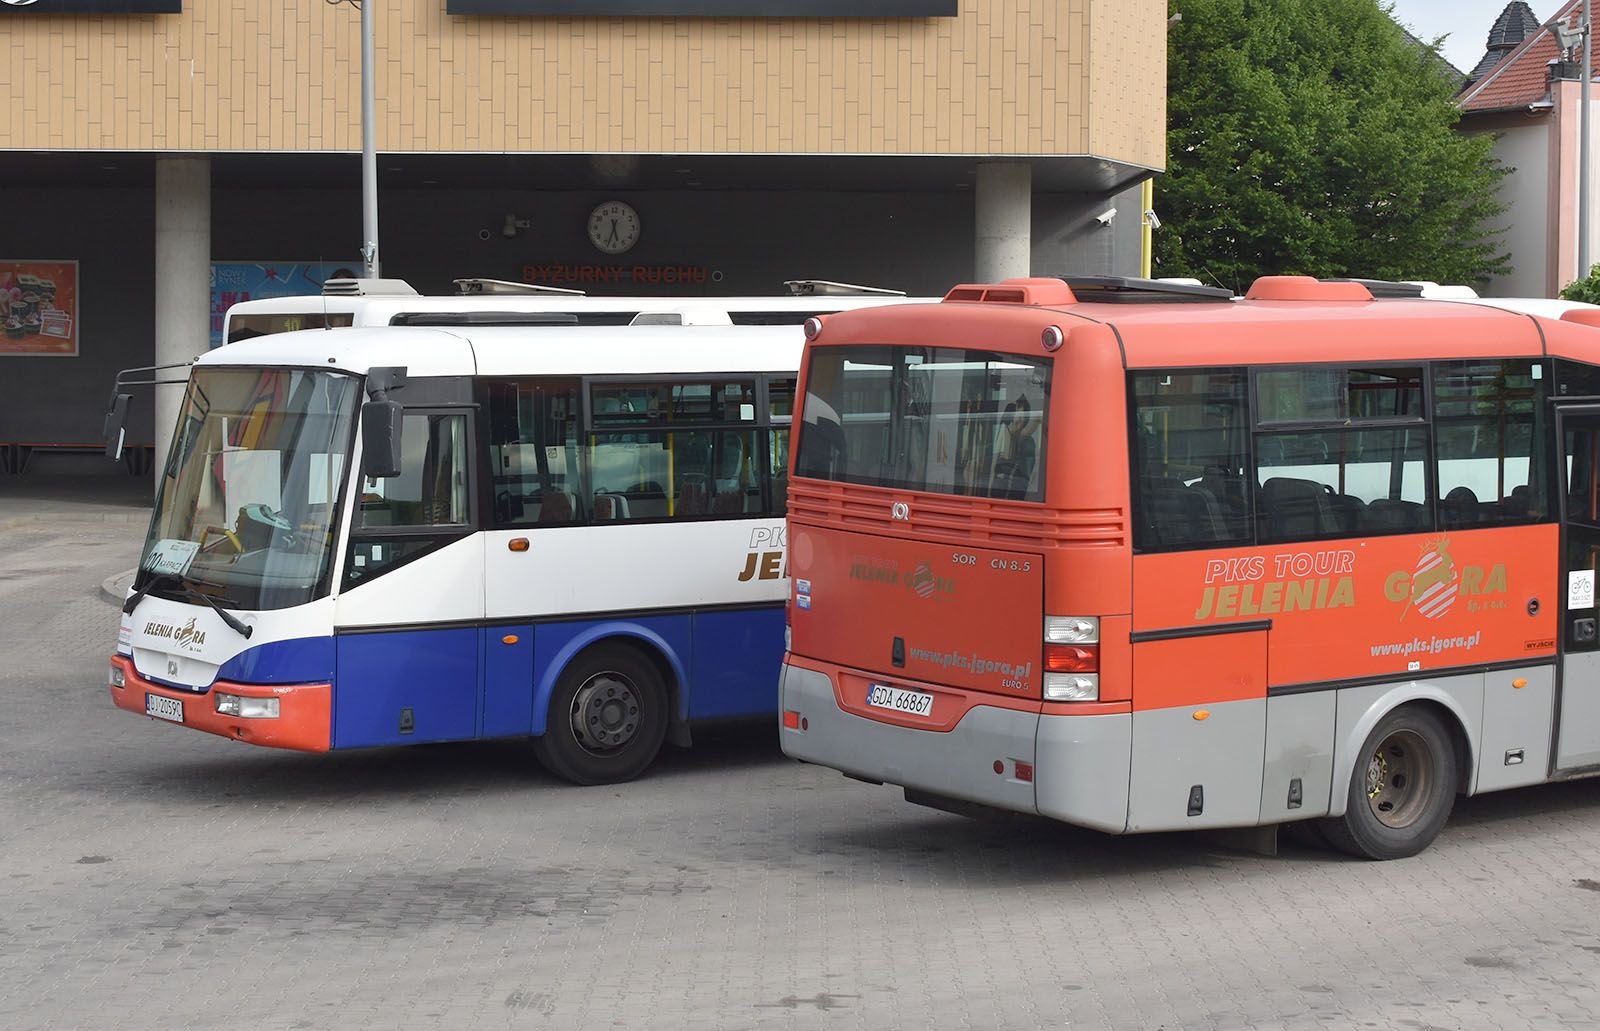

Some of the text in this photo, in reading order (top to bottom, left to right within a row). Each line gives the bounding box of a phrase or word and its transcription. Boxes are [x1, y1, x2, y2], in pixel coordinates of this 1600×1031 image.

[522, 261, 707, 283] DYŻURNY RUCHU
[738, 552, 787, 582] JE
[952, 552, 1031, 572] SOR CN 8.5
[1204, 550, 1356, 584] PKS TOUR
[1194, 576, 1355, 620] JELENIA
[143, 622, 174, 639] JELENIA
[1370, 630, 1481, 656] www.pks.jgora.pl
[1002, 679, 1022, 689] EURO
[872, 687, 931, 713] GDA 66867
